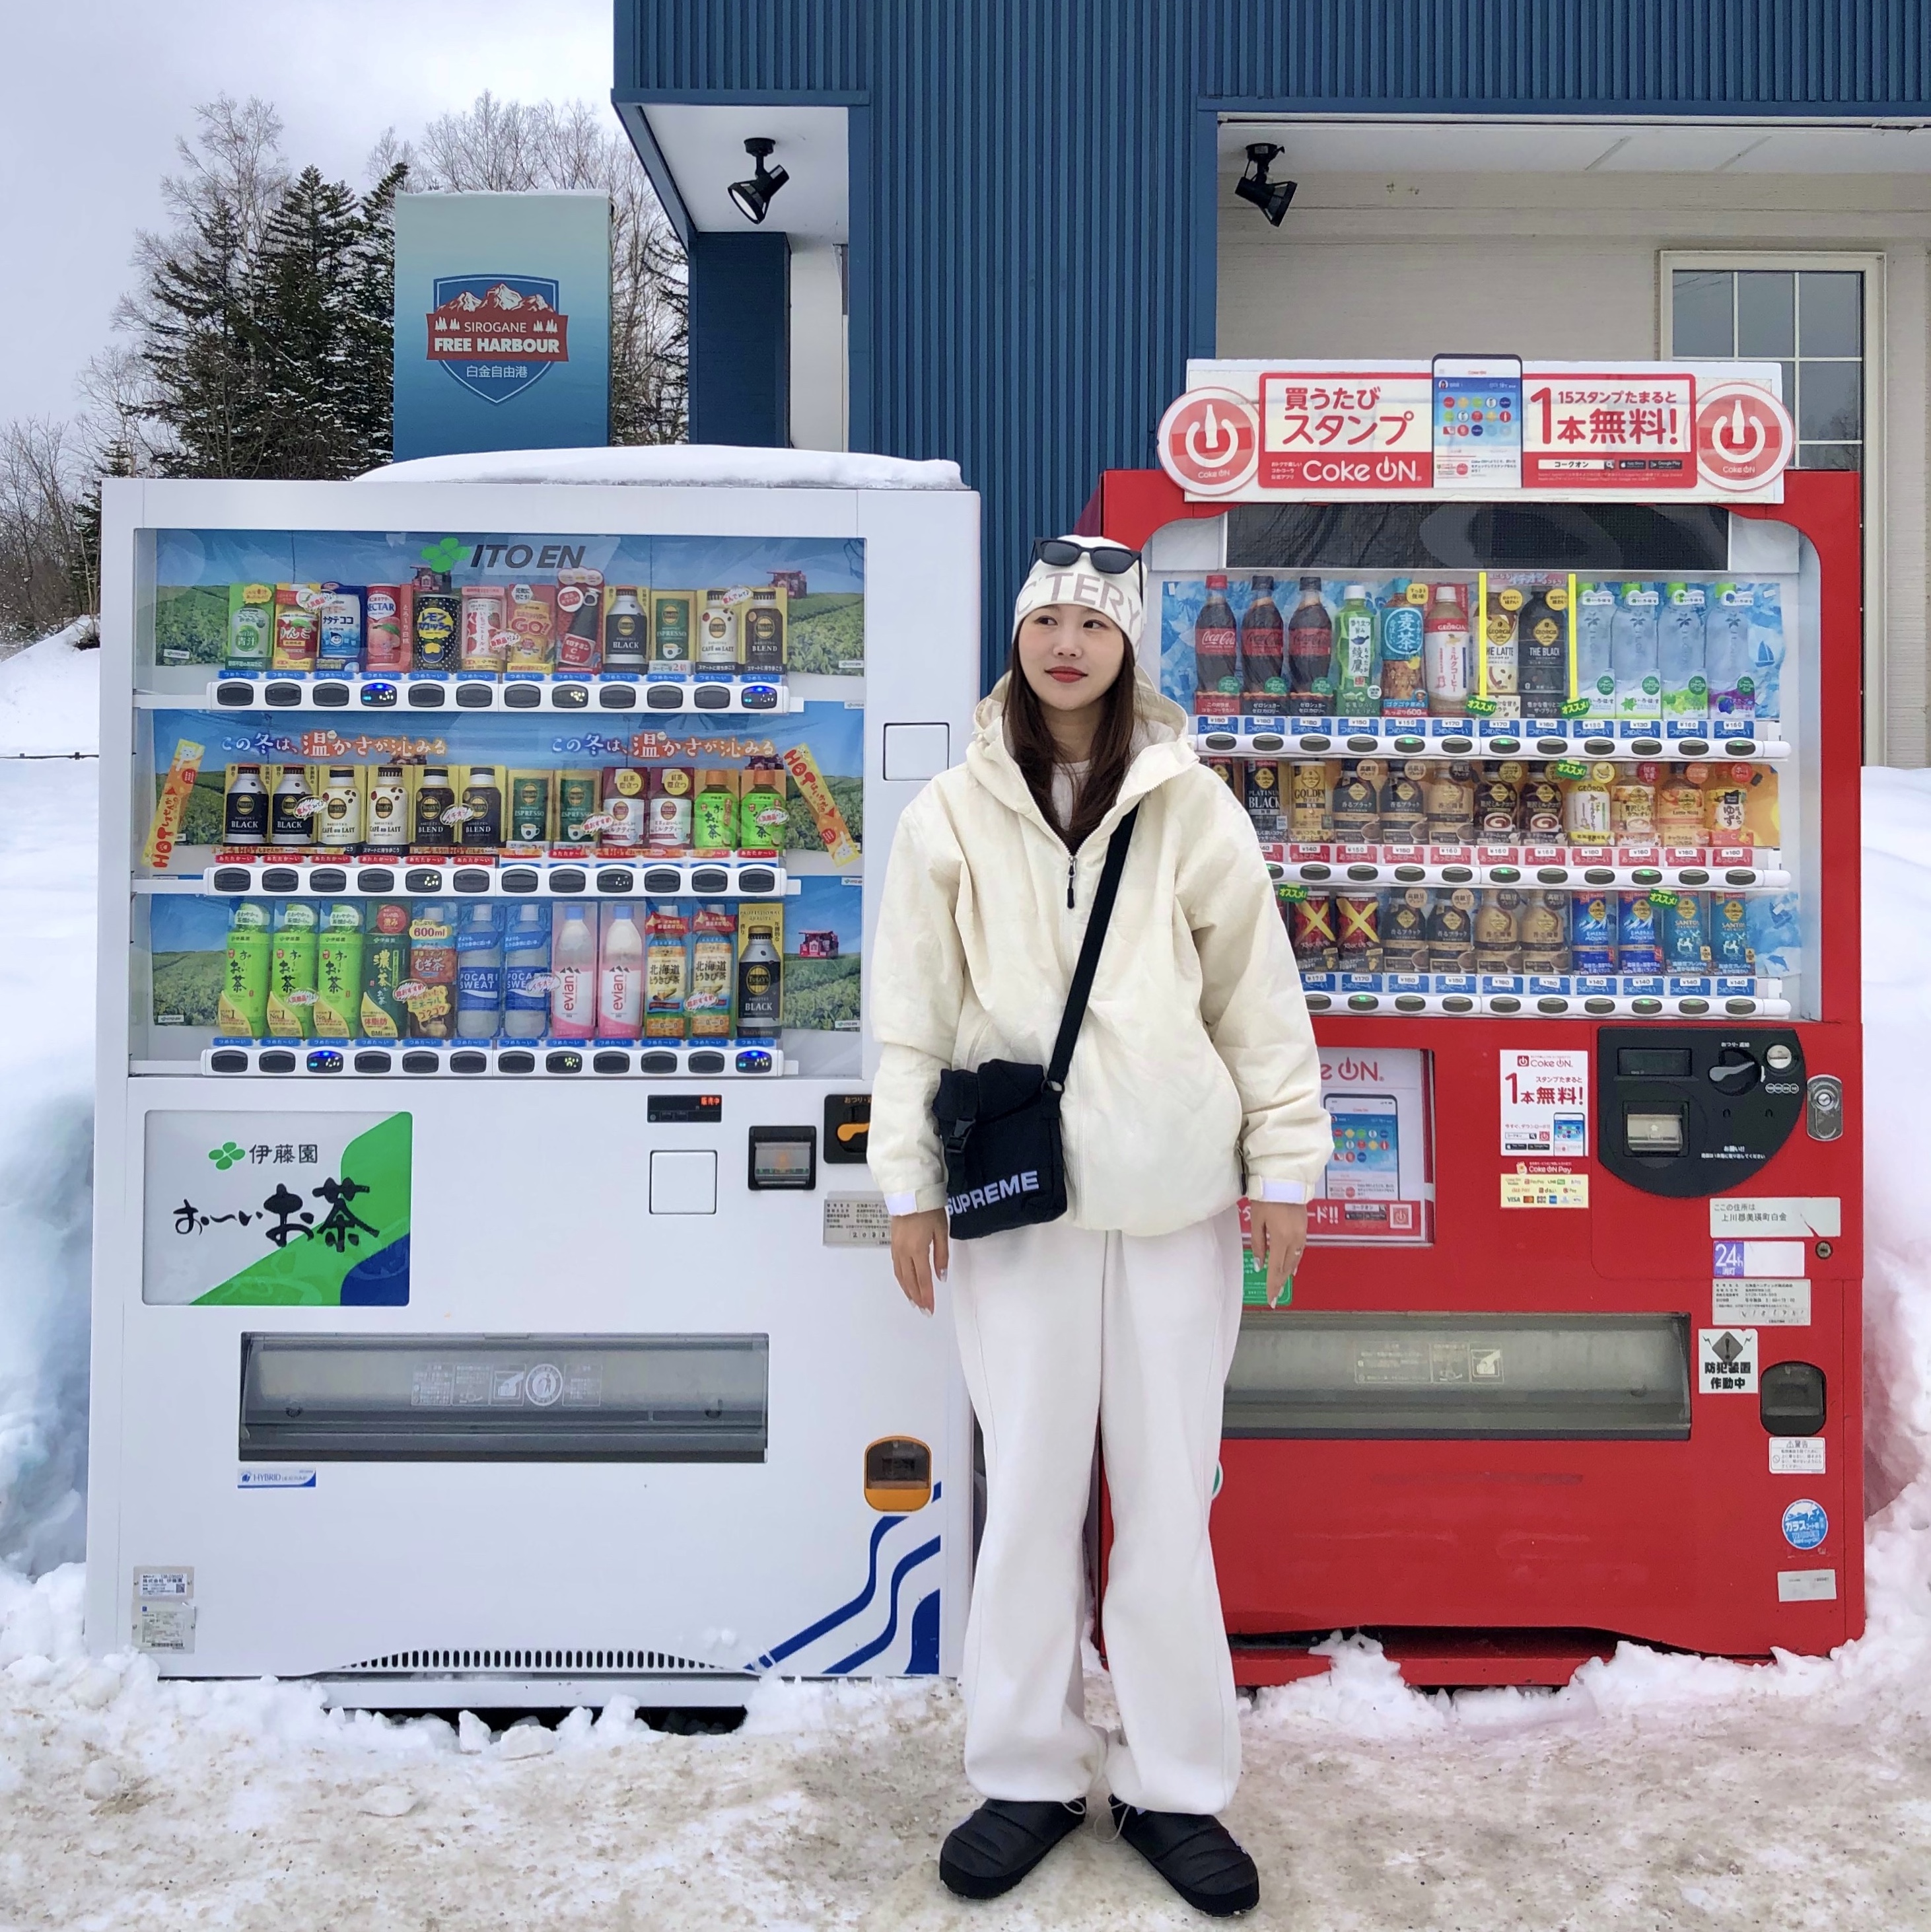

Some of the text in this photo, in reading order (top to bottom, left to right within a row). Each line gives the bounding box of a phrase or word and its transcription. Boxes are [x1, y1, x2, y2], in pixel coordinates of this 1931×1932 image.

[464, 322, 527, 333] SIROGANE
[435, 338, 560, 353] FREE HARBOUR
[466, 365, 528, 378] 白金自由港
[1285, 386, 1381, 411] 買うたび
[1558, 391, 1677, 404] 15スタンプたまると
[1282, 410, 1415, 447] スタンプ
[1302, 456, 1417, 482] Coke ON
[1722, 466, 1742, 474] Coke
[470, 544, 586, 569] ITO EN
[511, 618, 551, 635] GO!
[1396, 612, 1415, 651] 麦茶
[1496, 647, 1514, 657] LATTE
[1529, 647, 1541, 656] THE
[1351, 647, 1364, 673] 綾鷹
[1450, 647, 1459, 692] ミルクコーヒー
[1248, 796, 1281, 808] BLACK
[413, 927, 445, 937] 600ml
[415, 957, 445, 971] むぎ茶
[650, 964, 680, 975] 北海道
[695, 961, 726, 972] 北海道
[649, 975, 680, 985] とうきび茶
[695, 972, 726, 982] とうきび茶
[563, 974, 574, 1011] evian
[612, 974, 623, 1011] evian
[745, 1002, 773, 1011] BLACK
[1530, 1058, 1571, 1068] Coke ON
[249, 1144, 318, 1164] 伊藤園
[1547, 1164, 1558, 1173] ON
[1558, 1165, 1572, 1174] Pay
[947, 1170, 1039, 1216] SUPREME
[1714, 1203, 1756, 1211] ここの住所は
[1704, 1361, 1751, 1375] 防犯装置
[1710, 1377, 1746, 1389] 作動中
